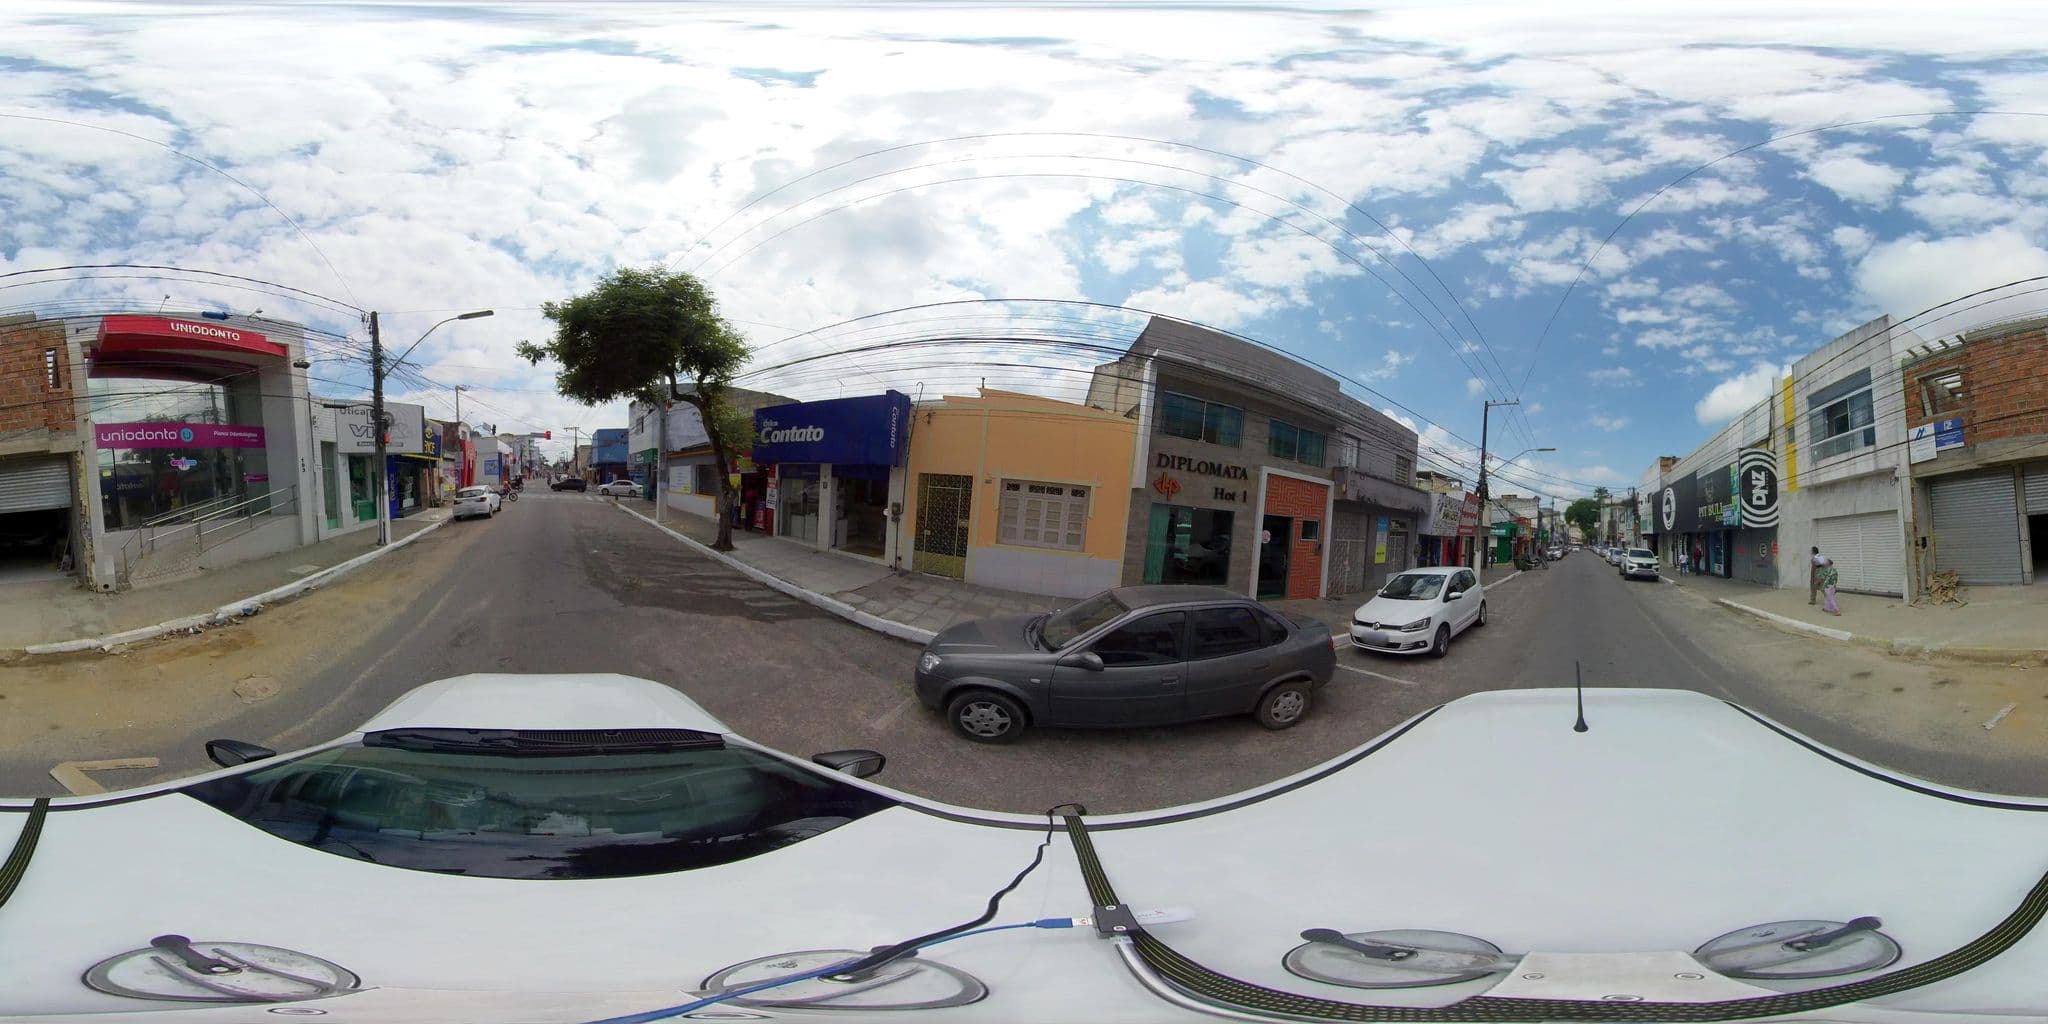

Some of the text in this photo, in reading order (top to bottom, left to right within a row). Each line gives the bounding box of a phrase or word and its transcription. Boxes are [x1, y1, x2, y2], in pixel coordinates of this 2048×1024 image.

[170, 322, 240, 341] UNIODONTO
[101, 427, 177, 442] uniodonto
[760, 425, 824, 443] Contato
[889, 406, 898, 448] Contato
[1157, 453, 1248, 480] DIPLOMATA
[1213, 487, 1247, 502] Hotl
